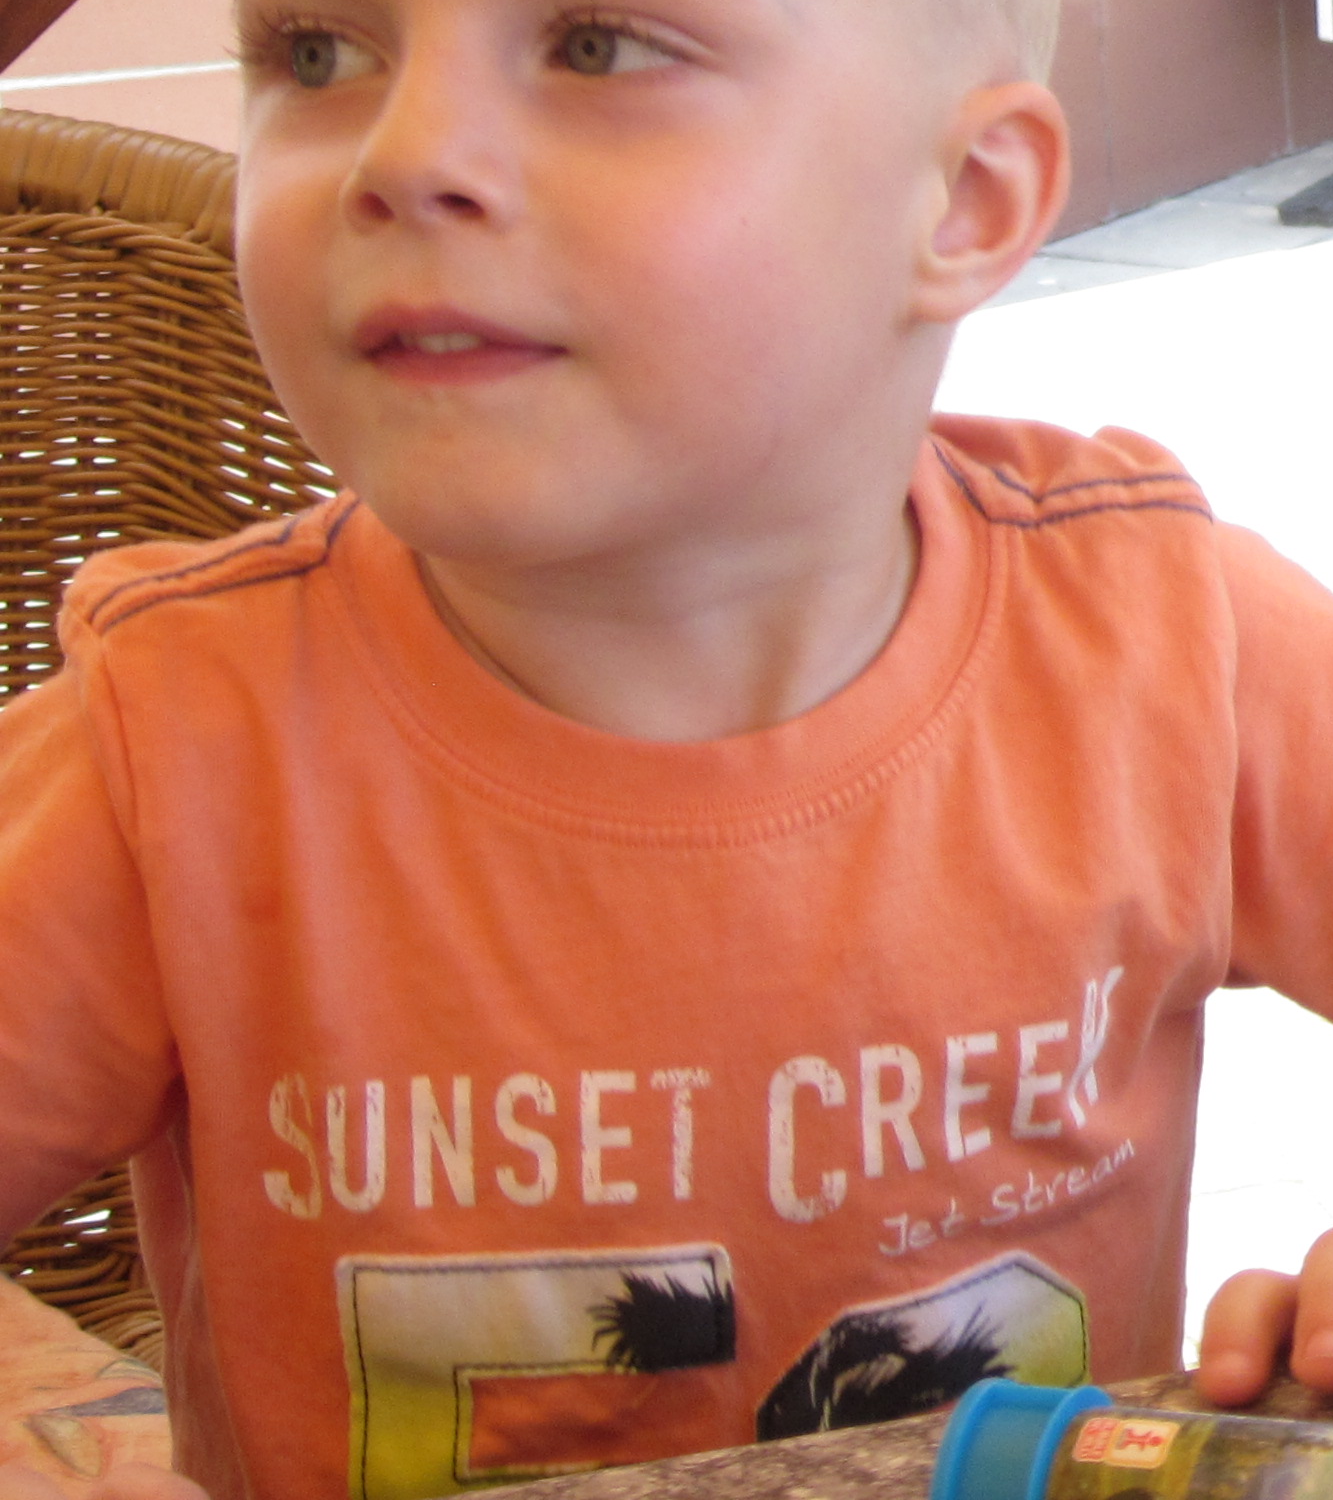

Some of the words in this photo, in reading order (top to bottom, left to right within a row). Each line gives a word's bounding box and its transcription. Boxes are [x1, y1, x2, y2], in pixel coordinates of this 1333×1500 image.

[261, 1067, 712, 1221] SUNSET
[766, 966, 1124, 1223] CREEK
[878, 1200, 962, 1257] Jet
[981, 1137, 1137, 1228] Stream
